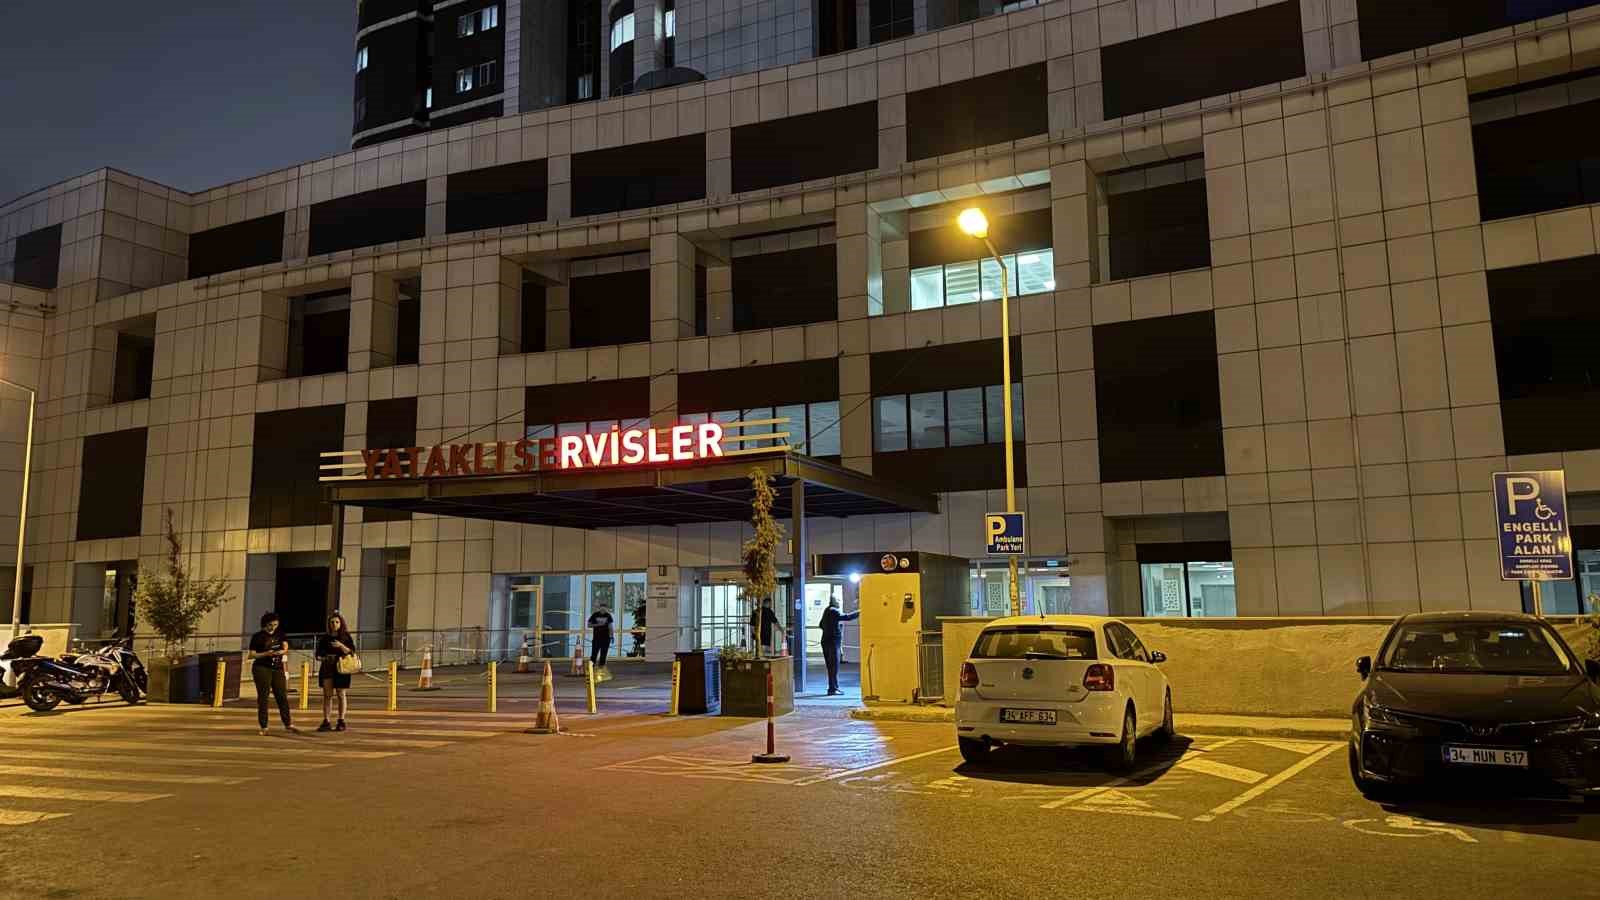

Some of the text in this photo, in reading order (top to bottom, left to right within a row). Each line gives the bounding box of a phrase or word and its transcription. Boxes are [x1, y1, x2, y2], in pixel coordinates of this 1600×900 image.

[361, 423, 724, 479] YATAKLI SERVİSLER
[1506, 477, 1540, 515] P
[987, 516, 1006, 545] P
[1515, 533, 1553, 544] PARK
[996, 543, 1022, 551] Park Yeri
[1514, 545, 1557, 555] ALANI
[1451, 749, 1525, 764] 34 MUN 617
